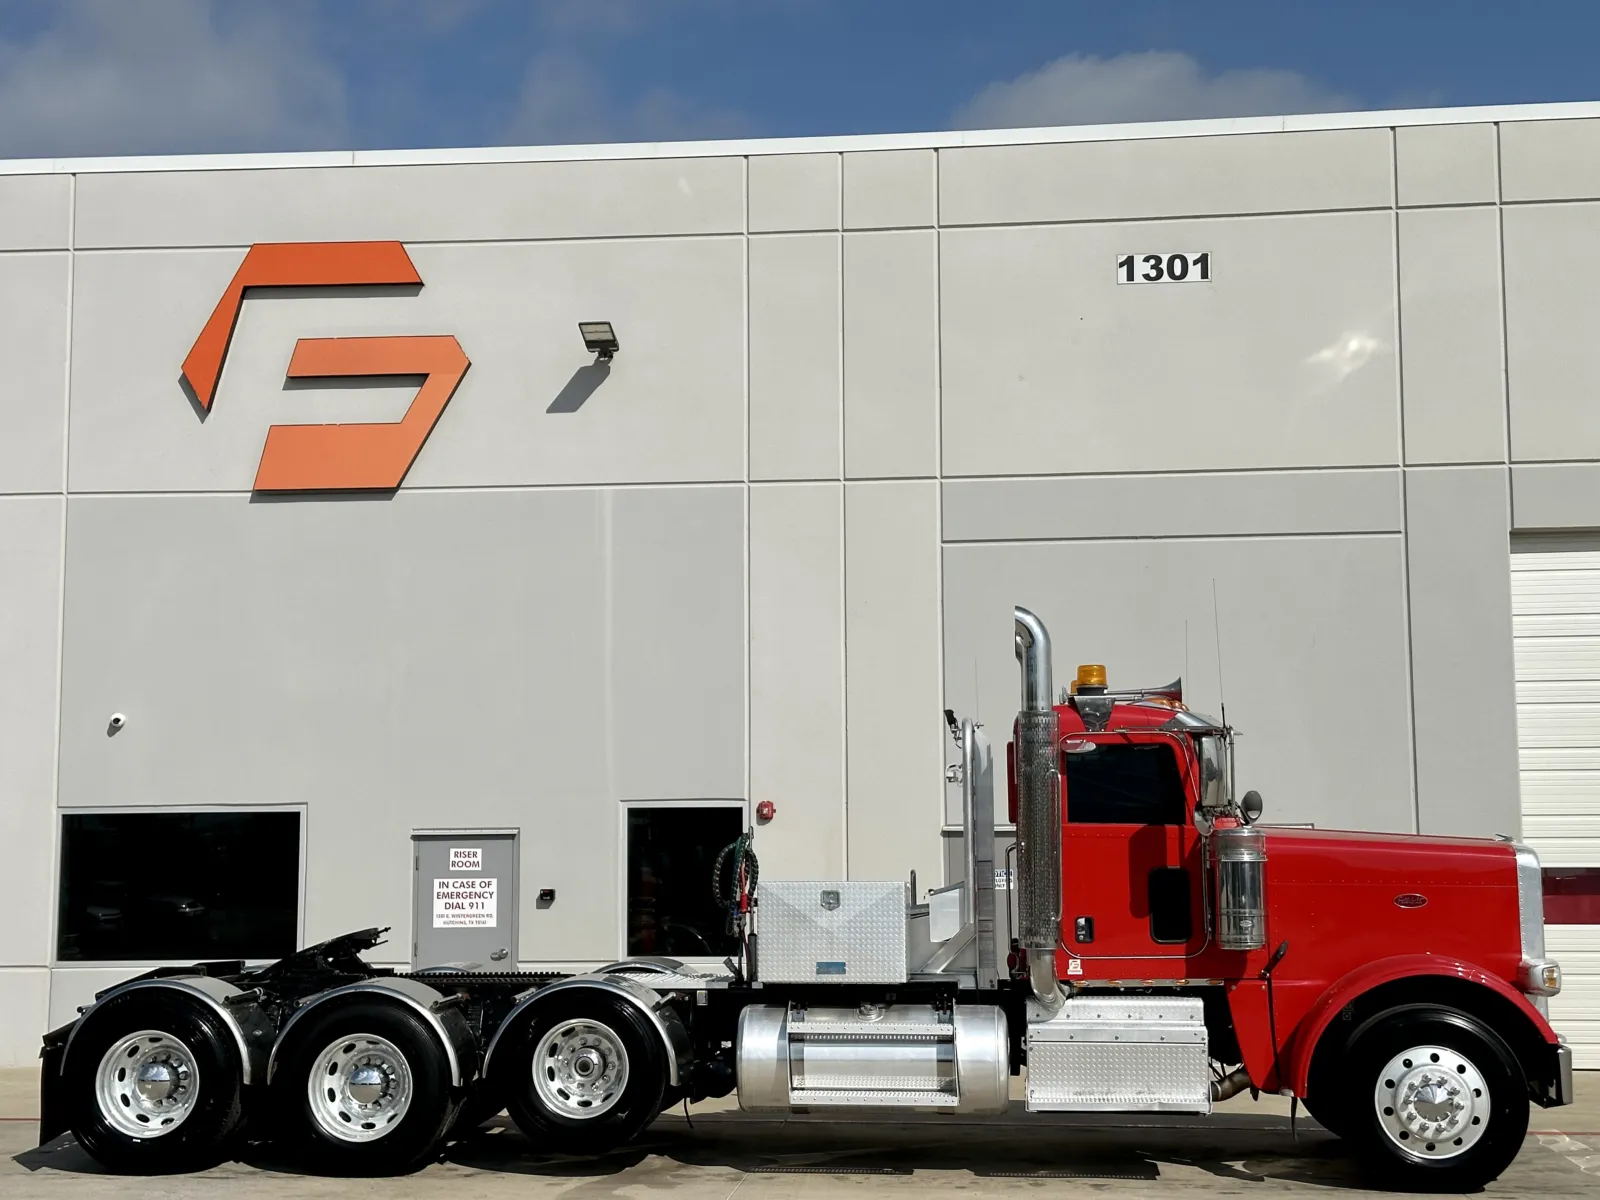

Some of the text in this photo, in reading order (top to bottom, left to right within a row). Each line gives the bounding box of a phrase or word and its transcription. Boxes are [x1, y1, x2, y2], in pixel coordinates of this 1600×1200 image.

[1118, 252, 1209, 282] 1301
[451, 860, 480, 868] ROOM
[438, 880, 493, 889] IN CASE OF
[436, 891, 494, 900] EMERGENCY
[444, 901, 485, 910] DIAL 911
